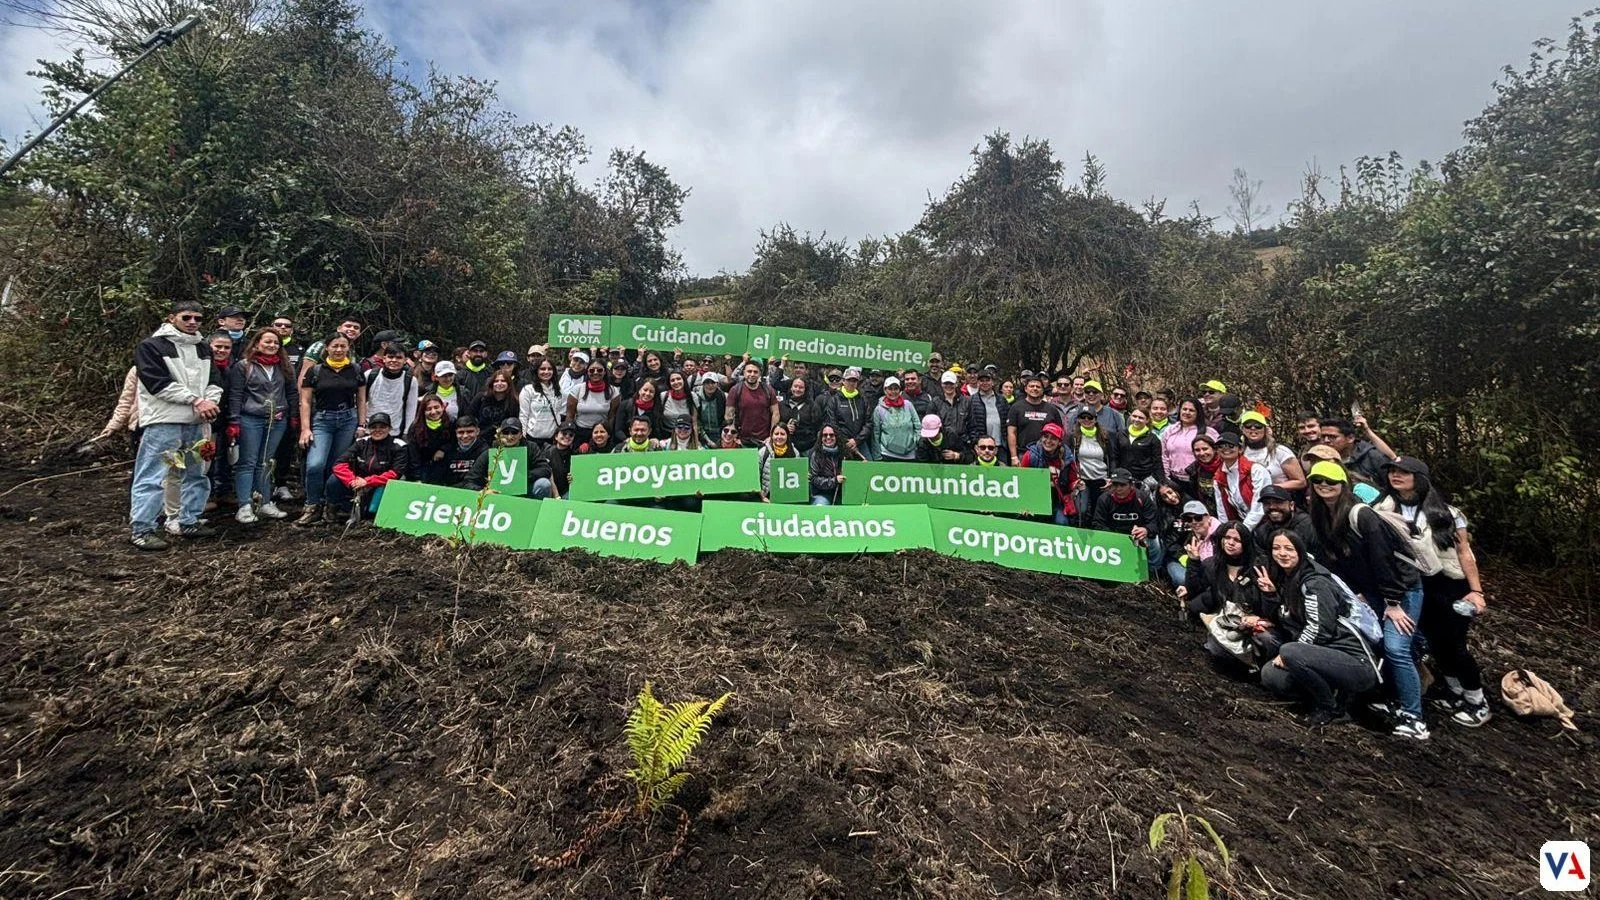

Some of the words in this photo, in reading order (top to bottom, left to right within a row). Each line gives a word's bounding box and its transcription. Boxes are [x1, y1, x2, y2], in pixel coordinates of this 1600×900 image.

[557, 318, 602, 335] ONE
[557, 335, 601, 345] TOYOTA
[631, 324, 726, 348] Cuidando
[753, 334, 769, 350] el
[778, 337, 927, 367] medioambiente,
[498, 459, 518, 485] y
[597, 457, 735, 490] apoyando
[777, 467, 800, 489] la
[869, 472, 1020, 499] comunidad
[405, 495, 513, 532] siendo
[561, 510, 673, 546] buenos
[741, 512, 896, 538] ciudadanos
[948, 523, 1121, 565] corporativos
